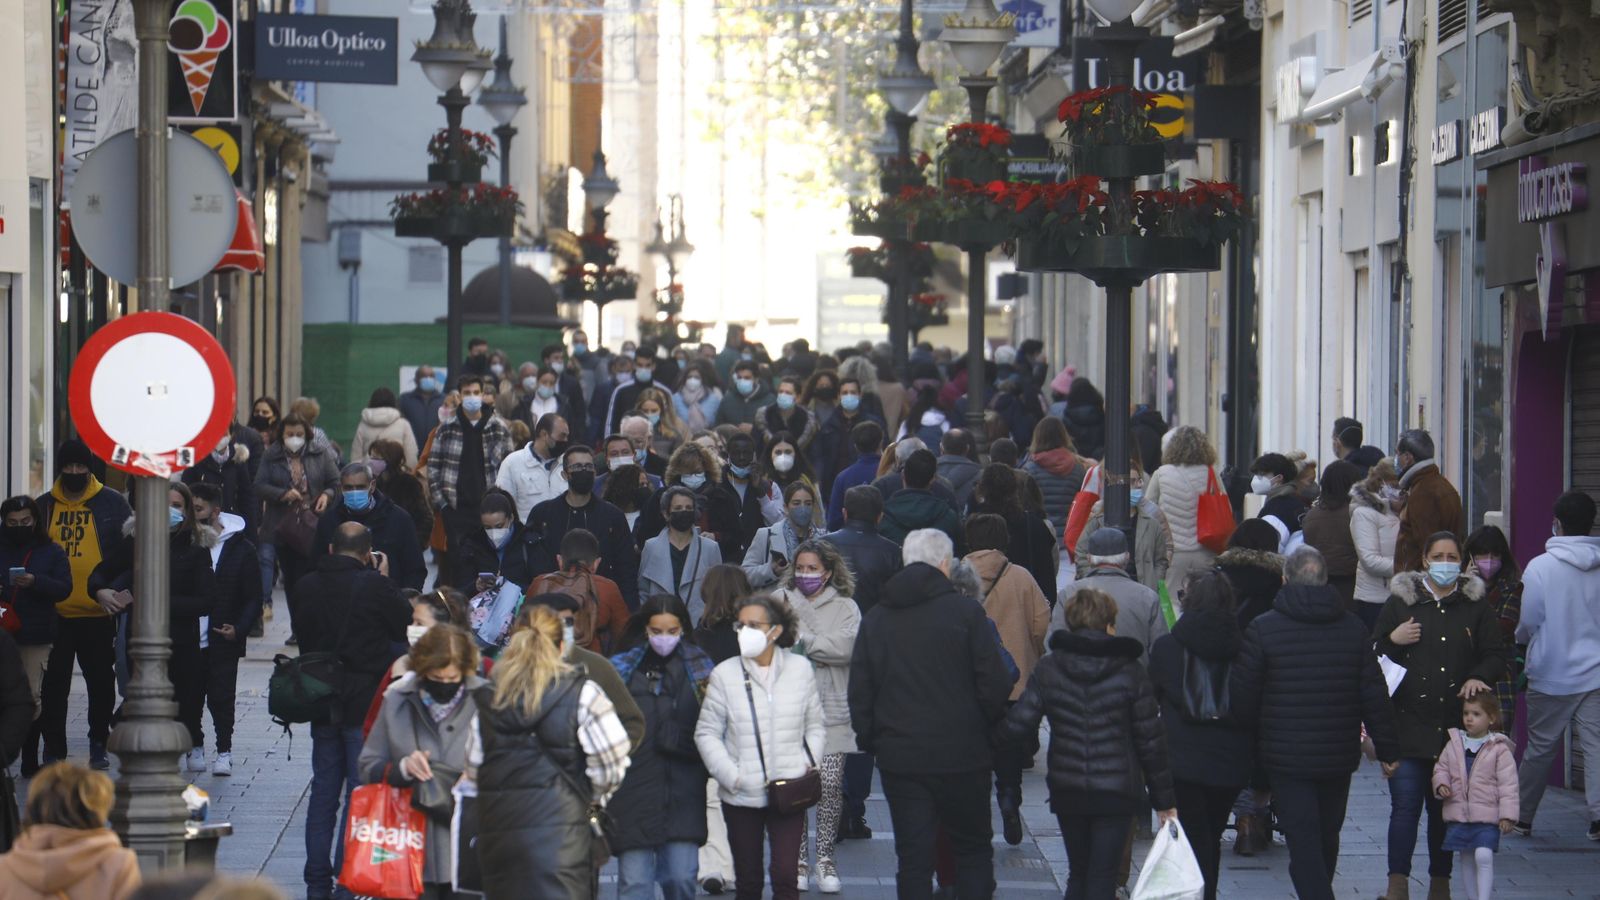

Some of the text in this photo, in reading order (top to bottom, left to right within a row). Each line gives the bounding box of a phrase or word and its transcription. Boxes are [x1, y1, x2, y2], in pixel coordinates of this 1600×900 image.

[76, 0, 101, 66] CAN
[267, 26, 386, 55] Ulloa Optico
[1083, 56, 1189, 92] Uloa
[72, 77, 99, 172] ATILDE
[1518, 155, 1573, 223] todocarcasas
[55, 511, 91, 525] JUST
[61, 526, 84, 541] DO
